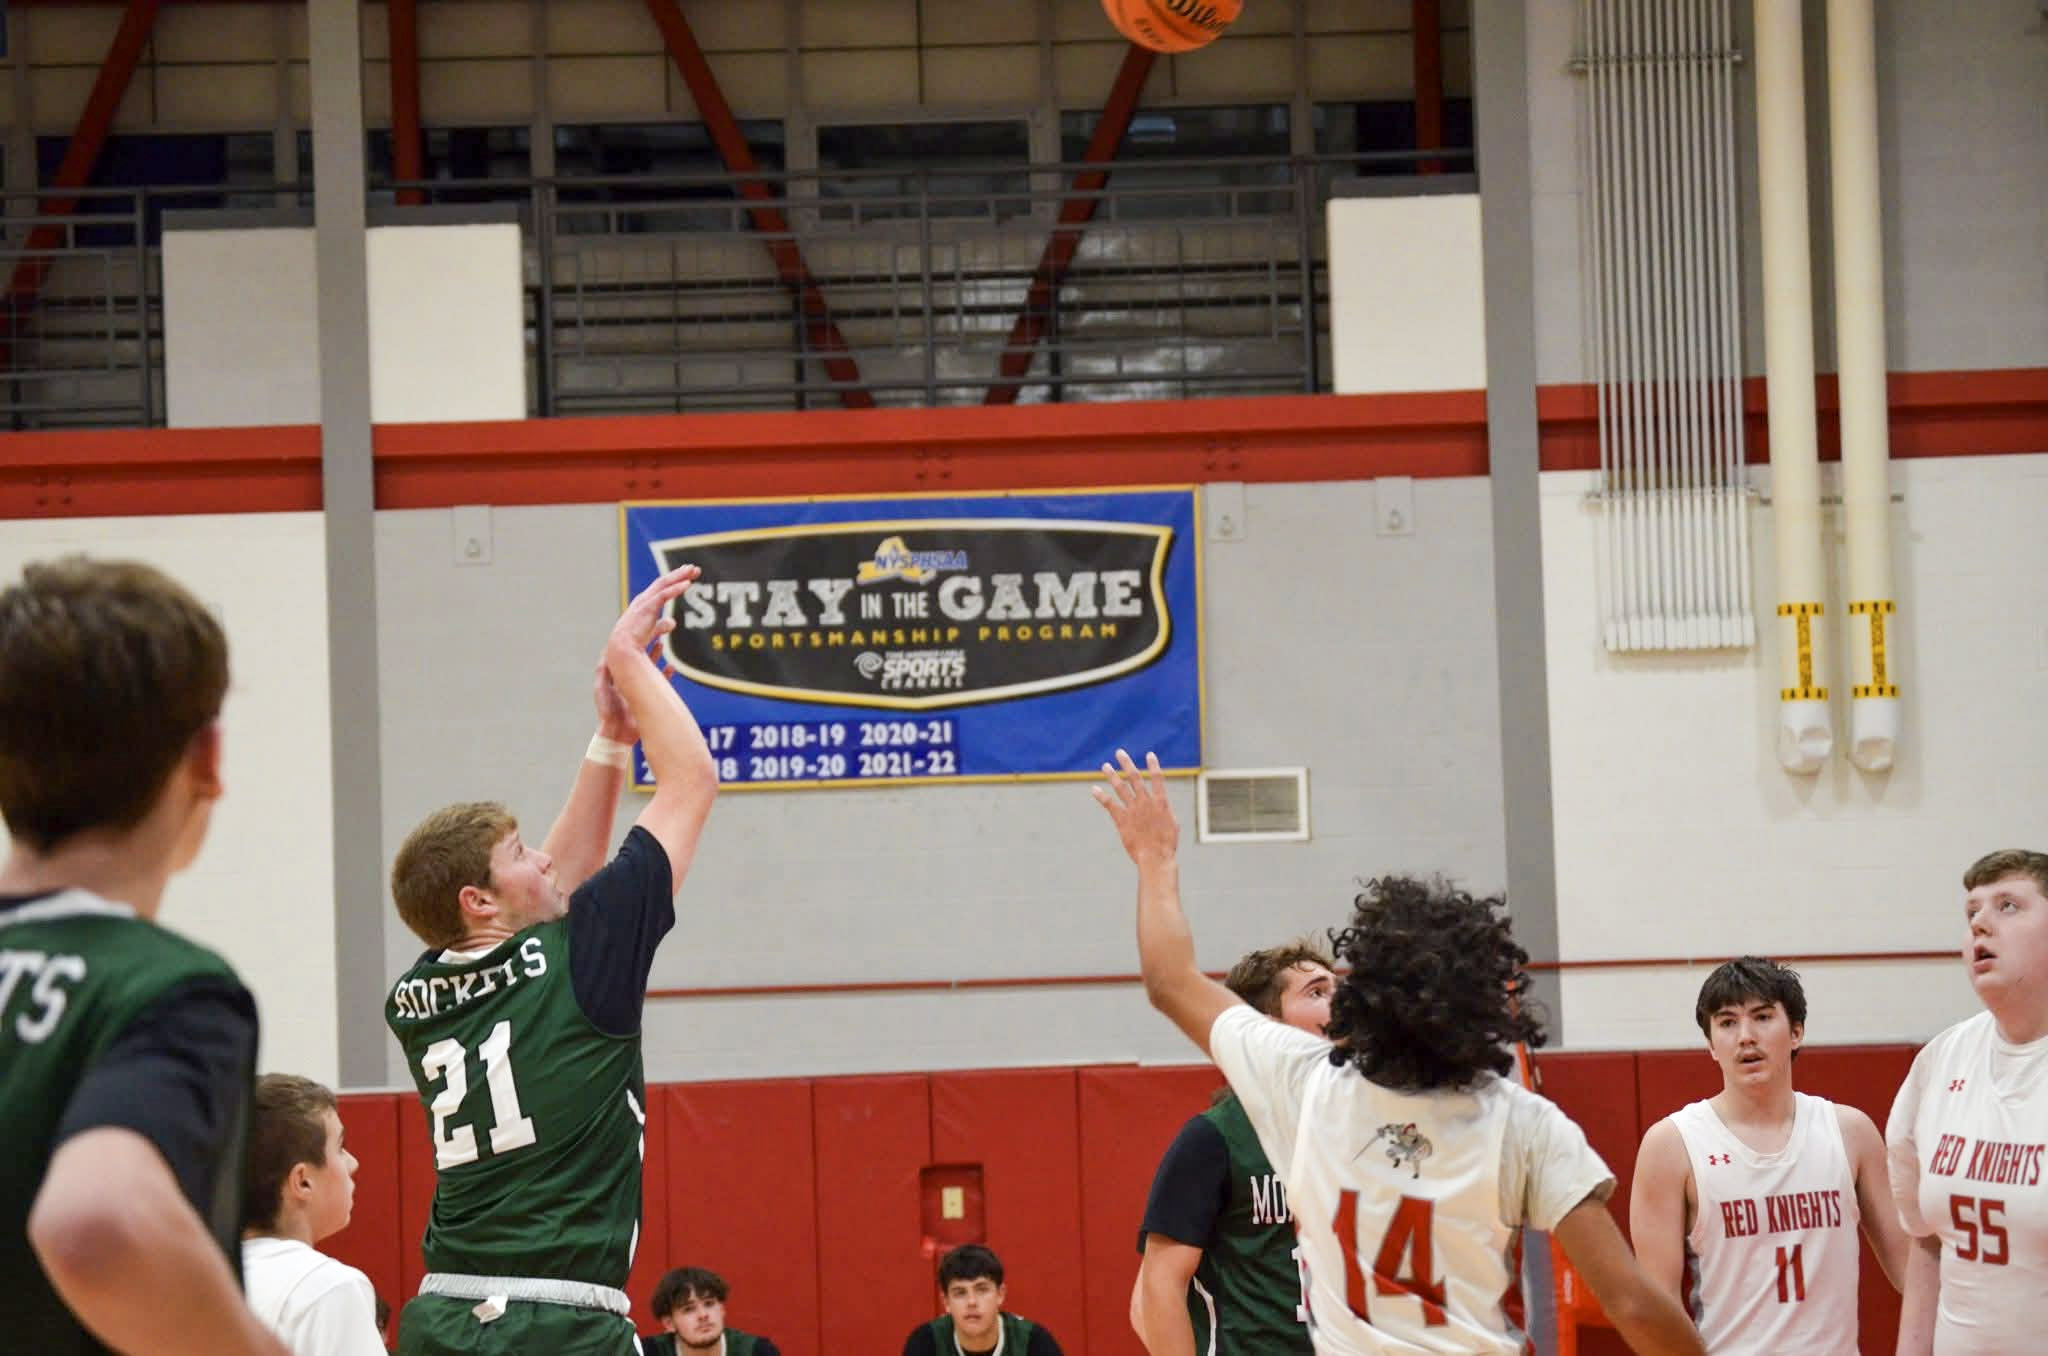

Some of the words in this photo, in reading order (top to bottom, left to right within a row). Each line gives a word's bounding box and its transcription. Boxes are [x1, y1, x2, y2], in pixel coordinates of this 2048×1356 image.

[684, 579, 853, 629] STAY
[861, 593, 882, 619] IN
[892, 591, 928, 619] THE
[938, 570, 1142, 621] GAME
[711, 626, 960, 648] SPORTSMANSHIP
[979, 623, 1117, 641] PROGRAM
[883, 656, 966, 678] SPORTS
[750, 723, 846, 749] 2018-19
[859, 720, 952, 745] 2020-21
[751, 754, 846, 780] 2019-20
[858, 751, 956, 776] 2021-22
[395, 937, 547, 1020] ROCKETS
[421, 1020, 537, 1170] 21
[1929, 1133, 1966, 1178] RED
[1965, 1139, 2046, 1187] KNIGHTS
[1250, 1174, 1295, 1225] MO
[1720, 1199, 1759, 1239] RED
[1767, 1190, 1841, 1235] KNIGHTS
[1949, 1194, 2010, 1266] 55
[1332, 1189, 1448, 1327] 14
[1776, 1244, 1806, 1304] 11
